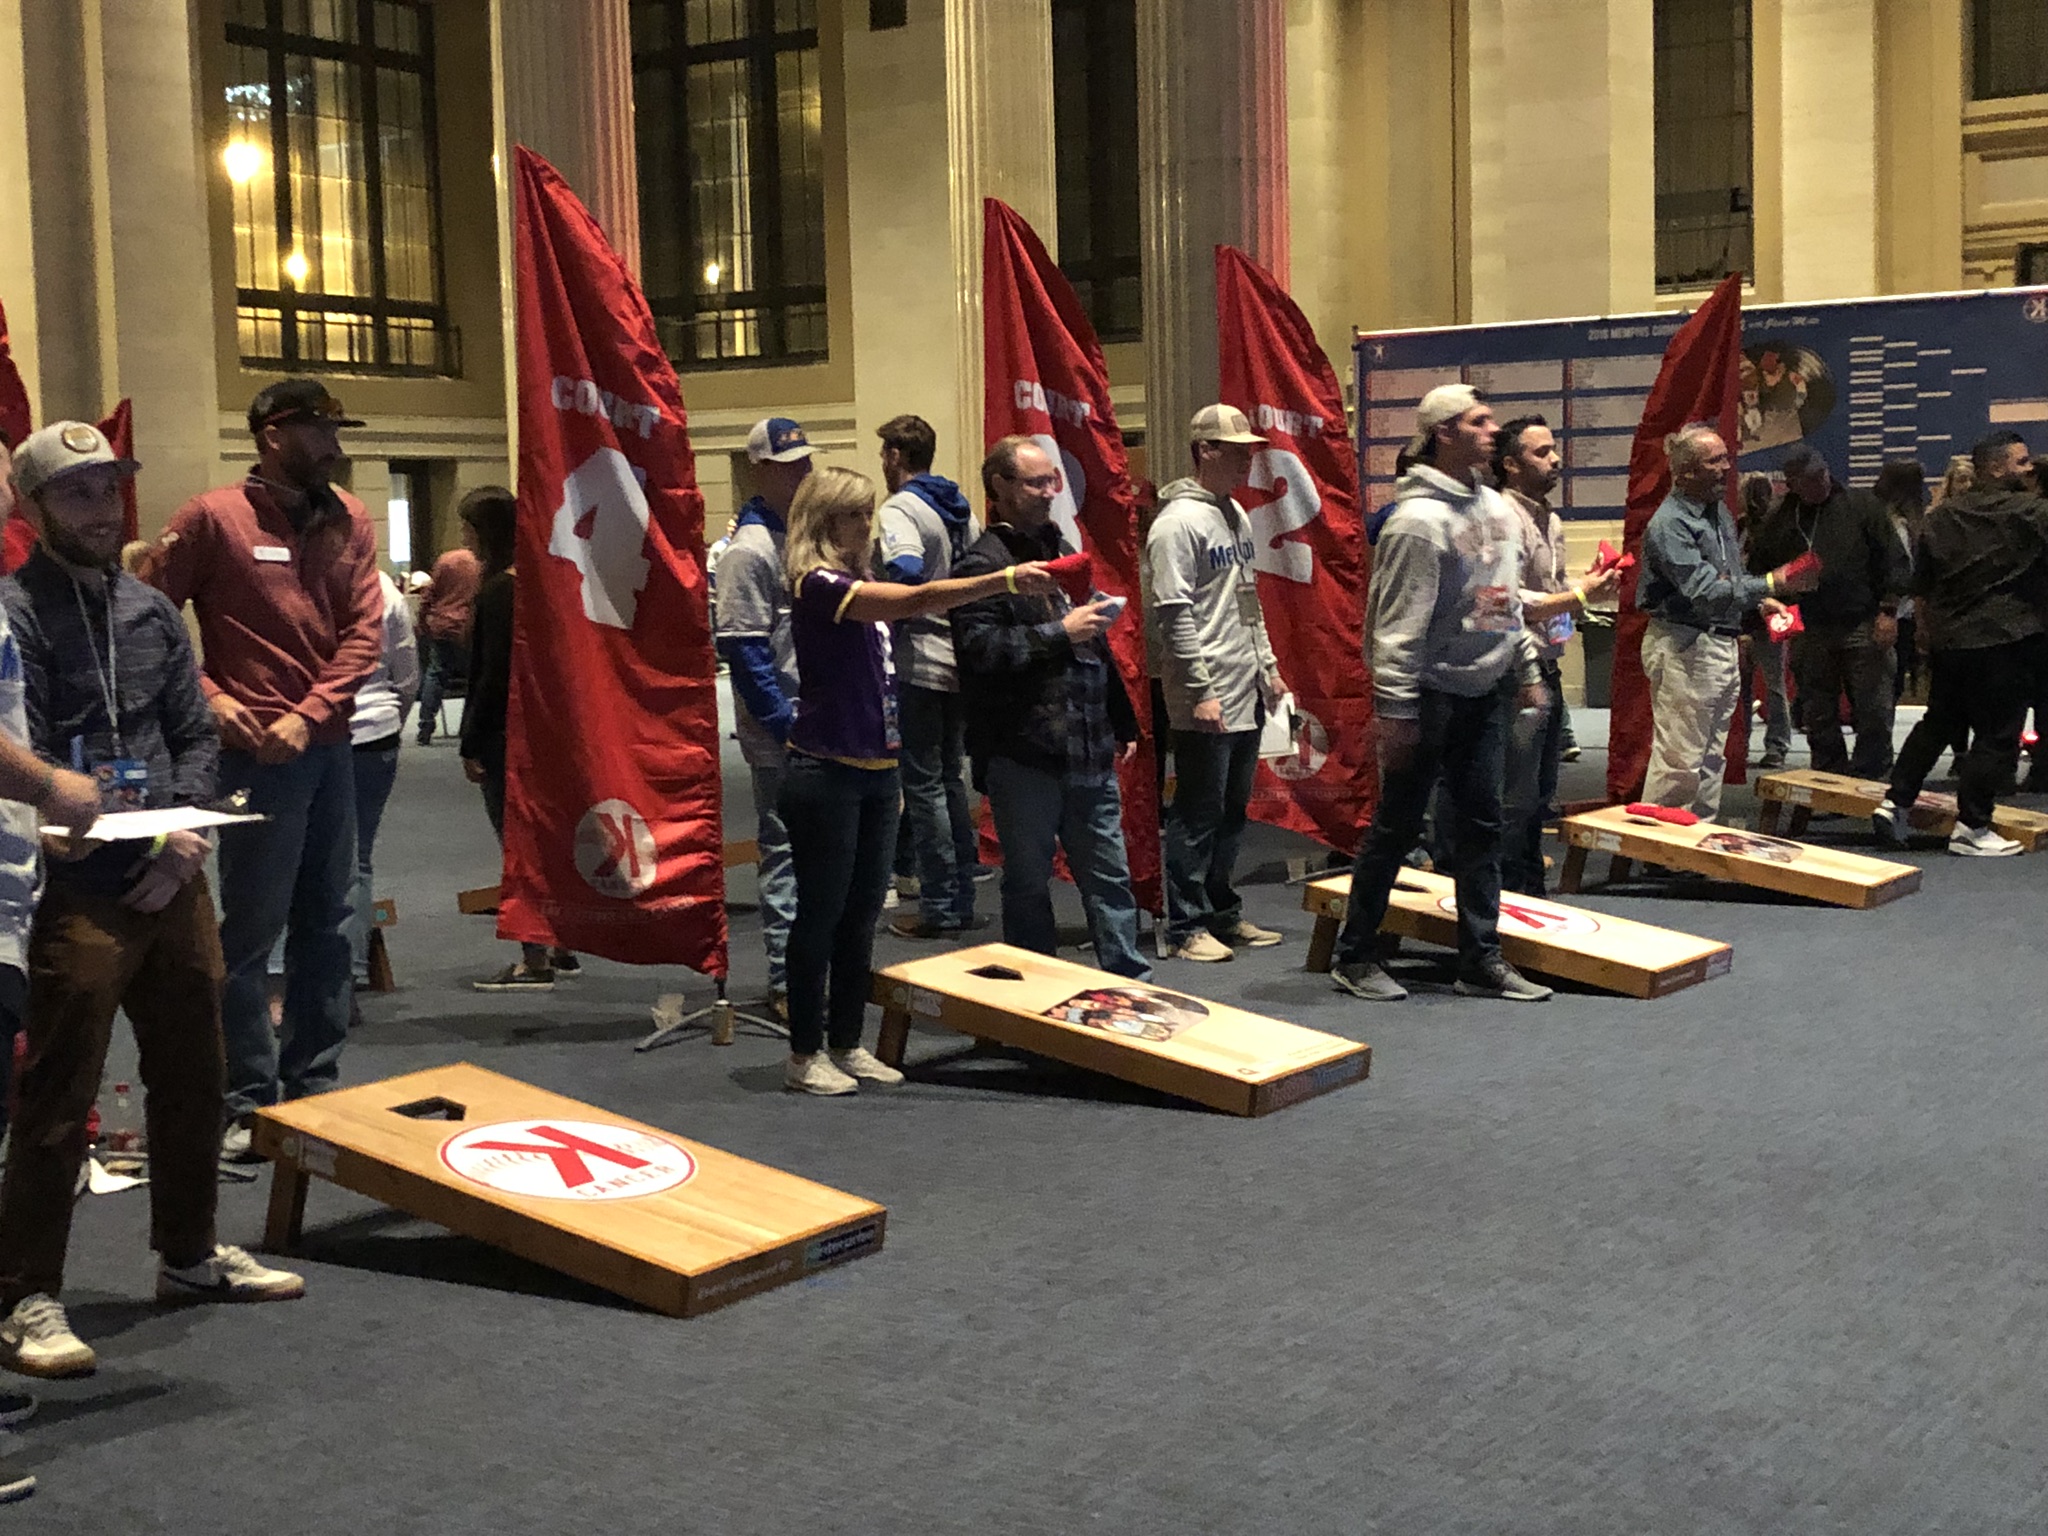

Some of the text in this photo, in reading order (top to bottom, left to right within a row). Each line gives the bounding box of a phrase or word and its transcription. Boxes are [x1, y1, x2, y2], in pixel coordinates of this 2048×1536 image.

[551, 375, 661, 439] COURT
[1014, 379, 1090, 430] COURT
[548, 446, 651, 630] 4
[1248, 448, 1321, 584] 2
[575, 1165, 676, 1197] CANCER
